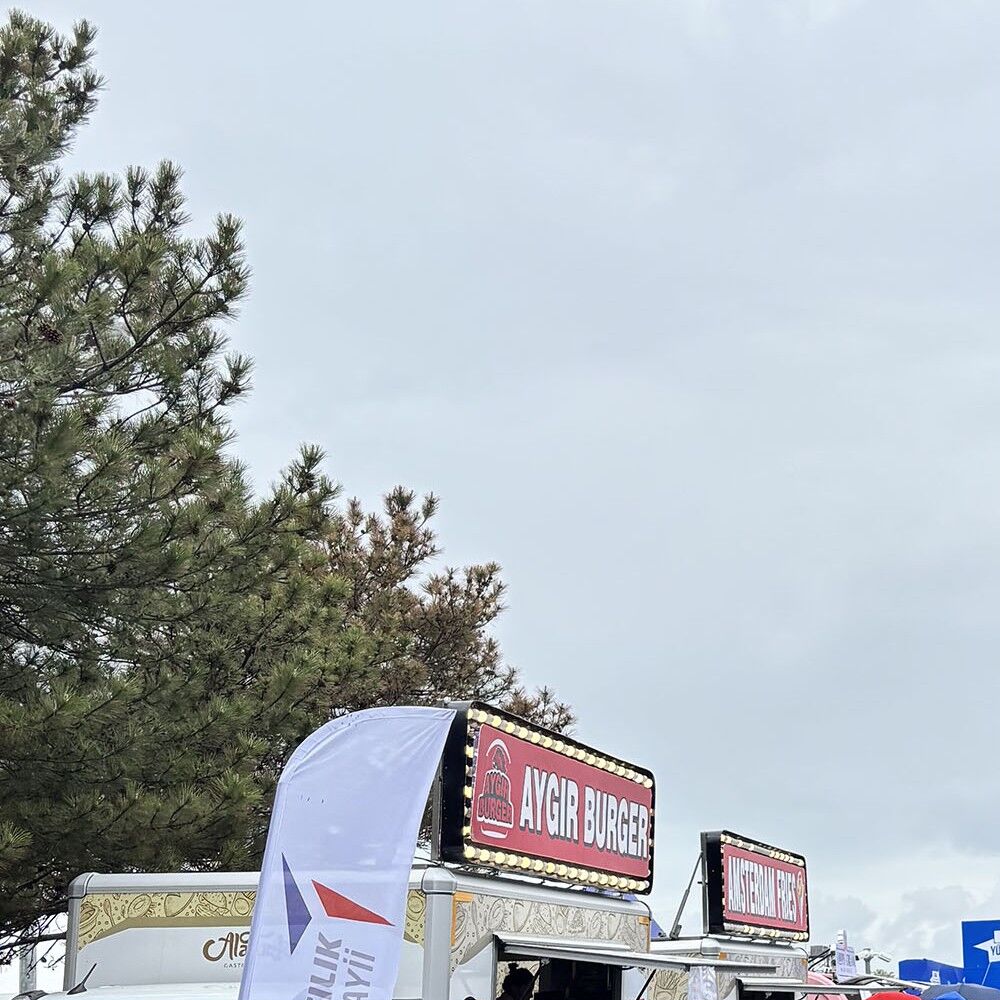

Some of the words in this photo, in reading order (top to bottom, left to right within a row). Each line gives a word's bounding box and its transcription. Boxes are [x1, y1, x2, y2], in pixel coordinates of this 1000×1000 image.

[478, 795, 513, 825] BURGER
[519, 764, 579, 845] AYGIR
[583, 785, 649, 859] BURGER
[728, 855, 776, 919] AMSTERDAM
[776, 869, 797, 924] FRIES
